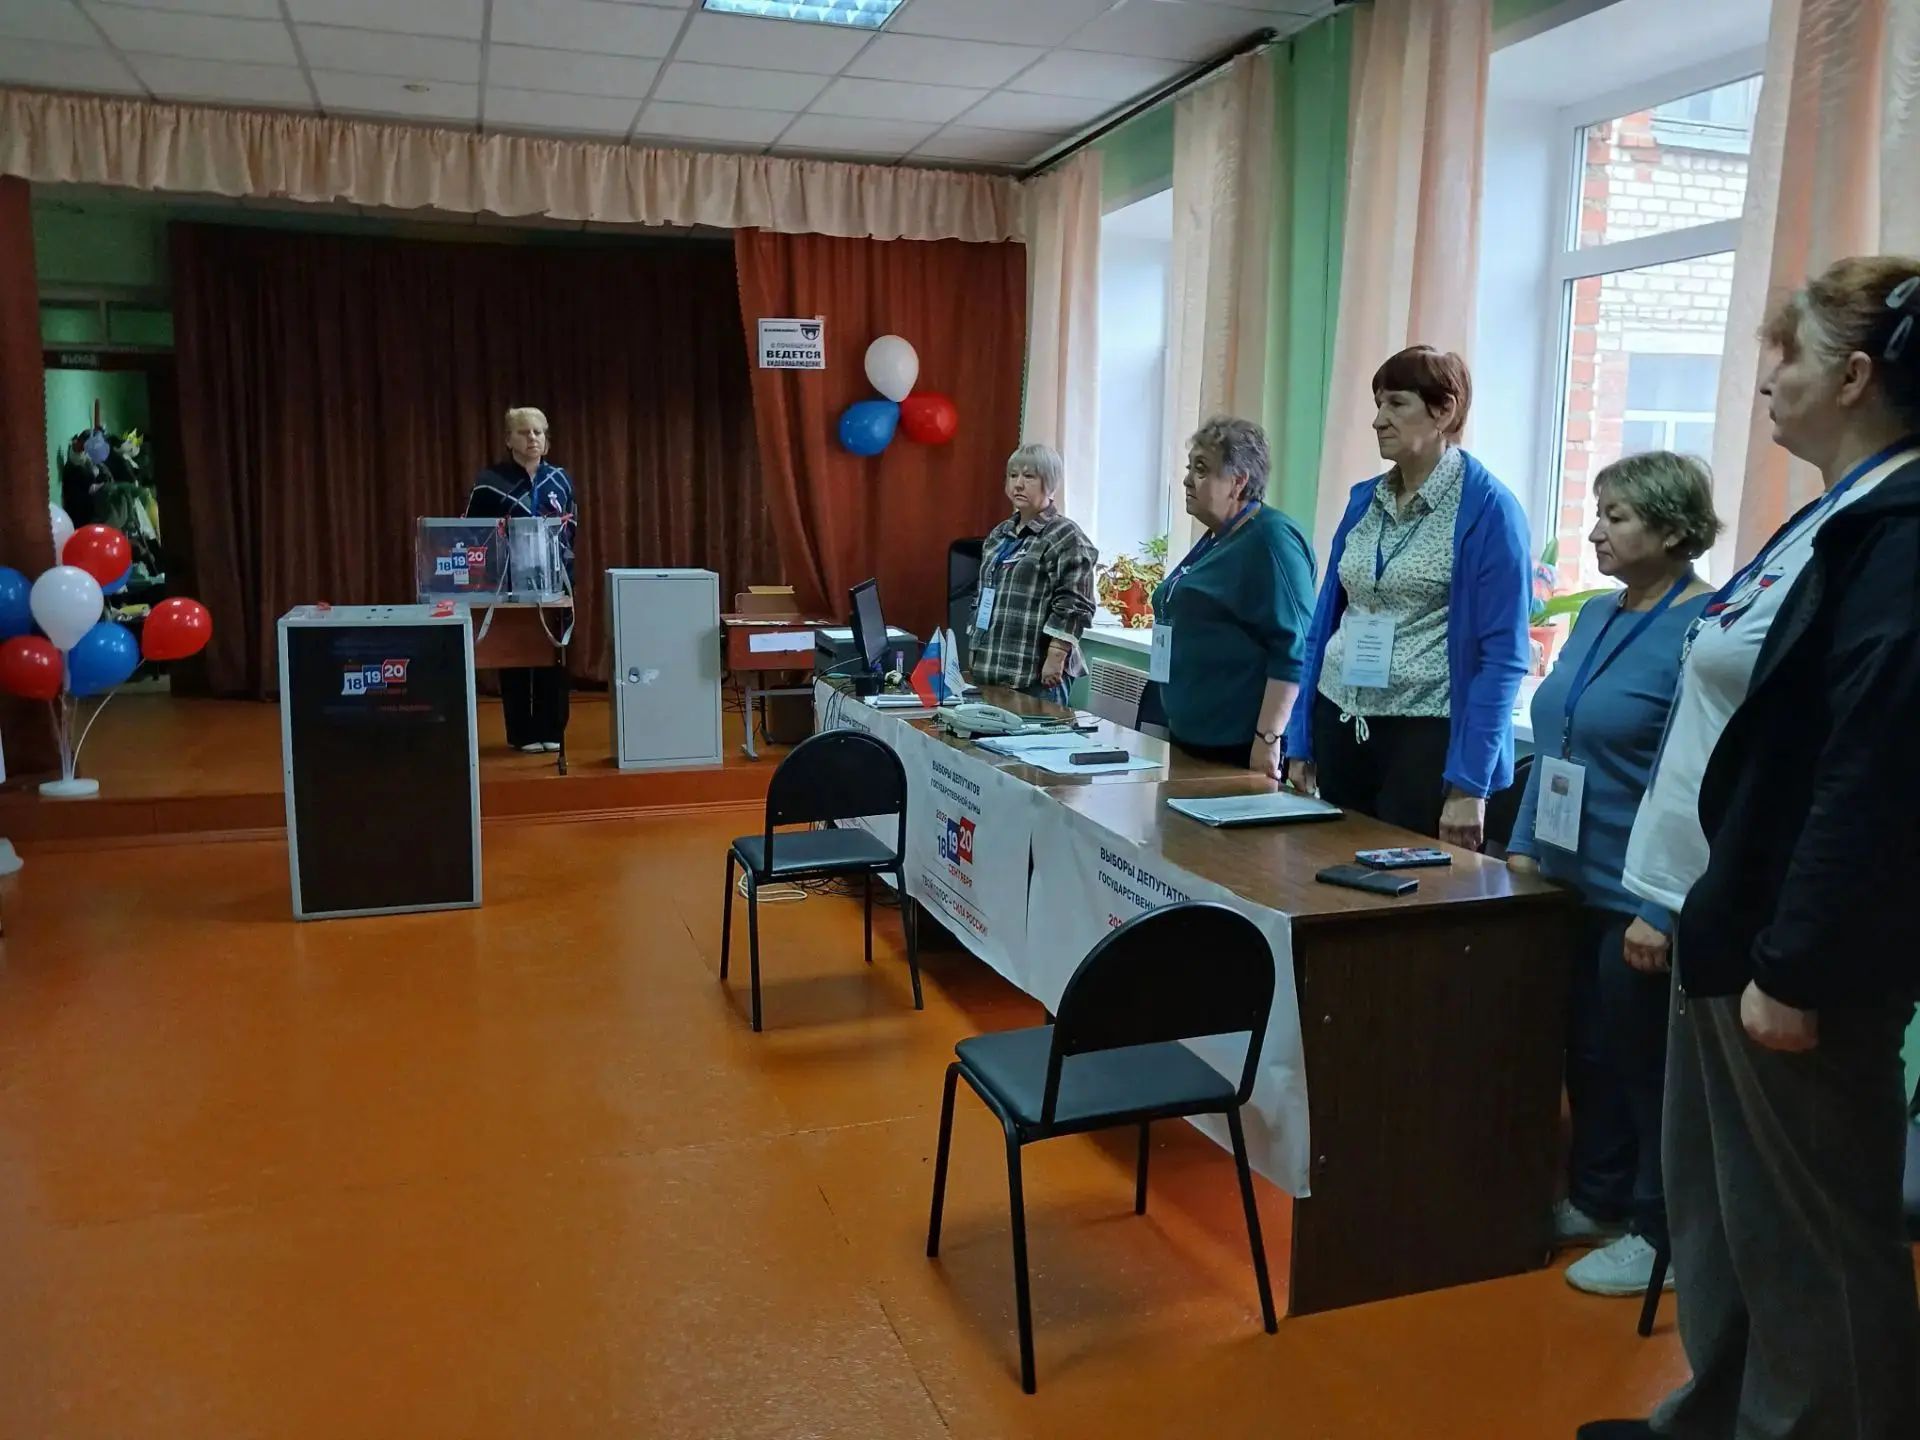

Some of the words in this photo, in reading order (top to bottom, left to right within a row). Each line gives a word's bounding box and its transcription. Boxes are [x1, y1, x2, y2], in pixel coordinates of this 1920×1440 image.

[766, 350, 821, 359] ВЕДЕТСЯ
[438, 560, 451, 571] 18
[453, 556, 466, 567] 19
[468, 551, 484, 562] 20
[346, 677, 362, 690] 18
[365, 670, 381, 683] 19
[384, 665, 404, 677] 20
[932, 760, 952, 780] ВЫБОРЫ
[951, 771, 981, 796] ДЕПУТАТОВ
[937, 834, 947, 859] 18
[947, 830, 958, 854] 19
[959, 825, 973, 853] 20
[1100, 847, 1135, 879] ВЫБОРЫ
